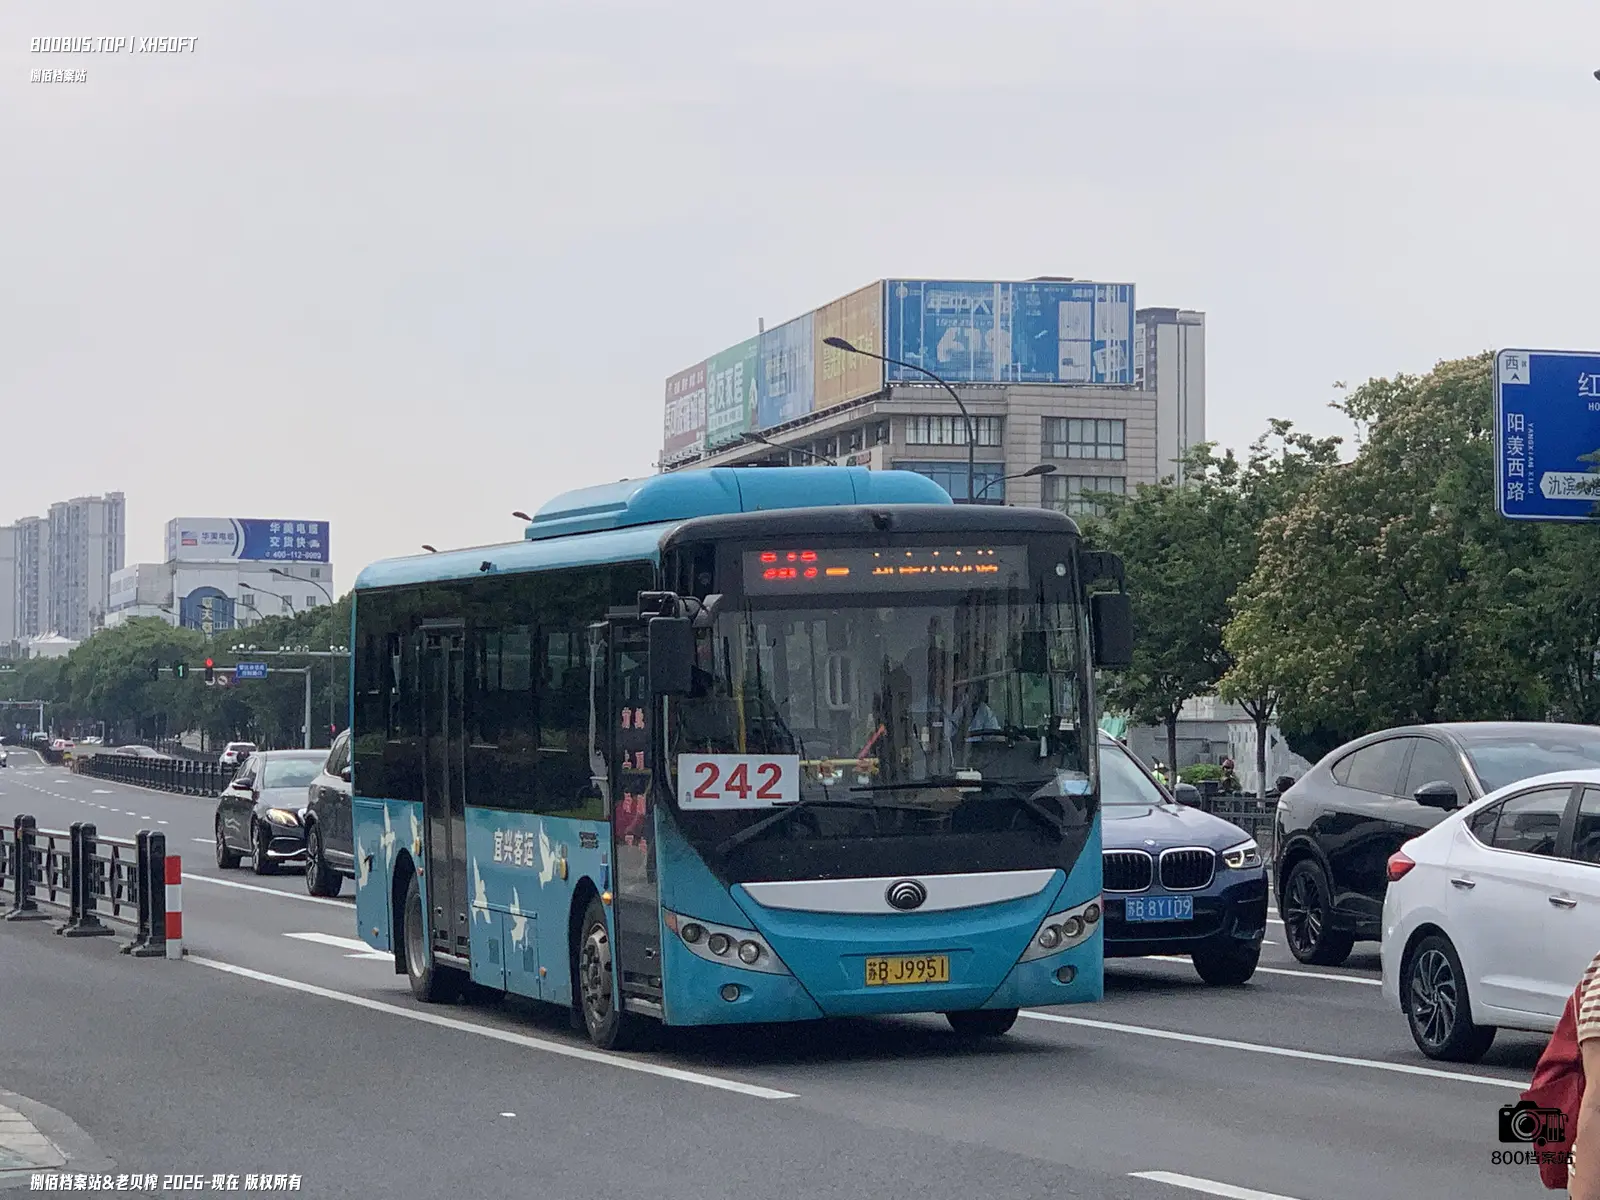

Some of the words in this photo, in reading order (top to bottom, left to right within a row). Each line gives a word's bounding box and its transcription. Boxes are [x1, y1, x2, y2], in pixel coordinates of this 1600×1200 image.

[1505, 355, 1519, 370] 西
[1578, 372, 1600, 397] 红
[1506, 413, 1525, 501] 阳羡西路
[694, 762, 782, 799] 242
[493, 827, 533, 867] 宜兴客运
